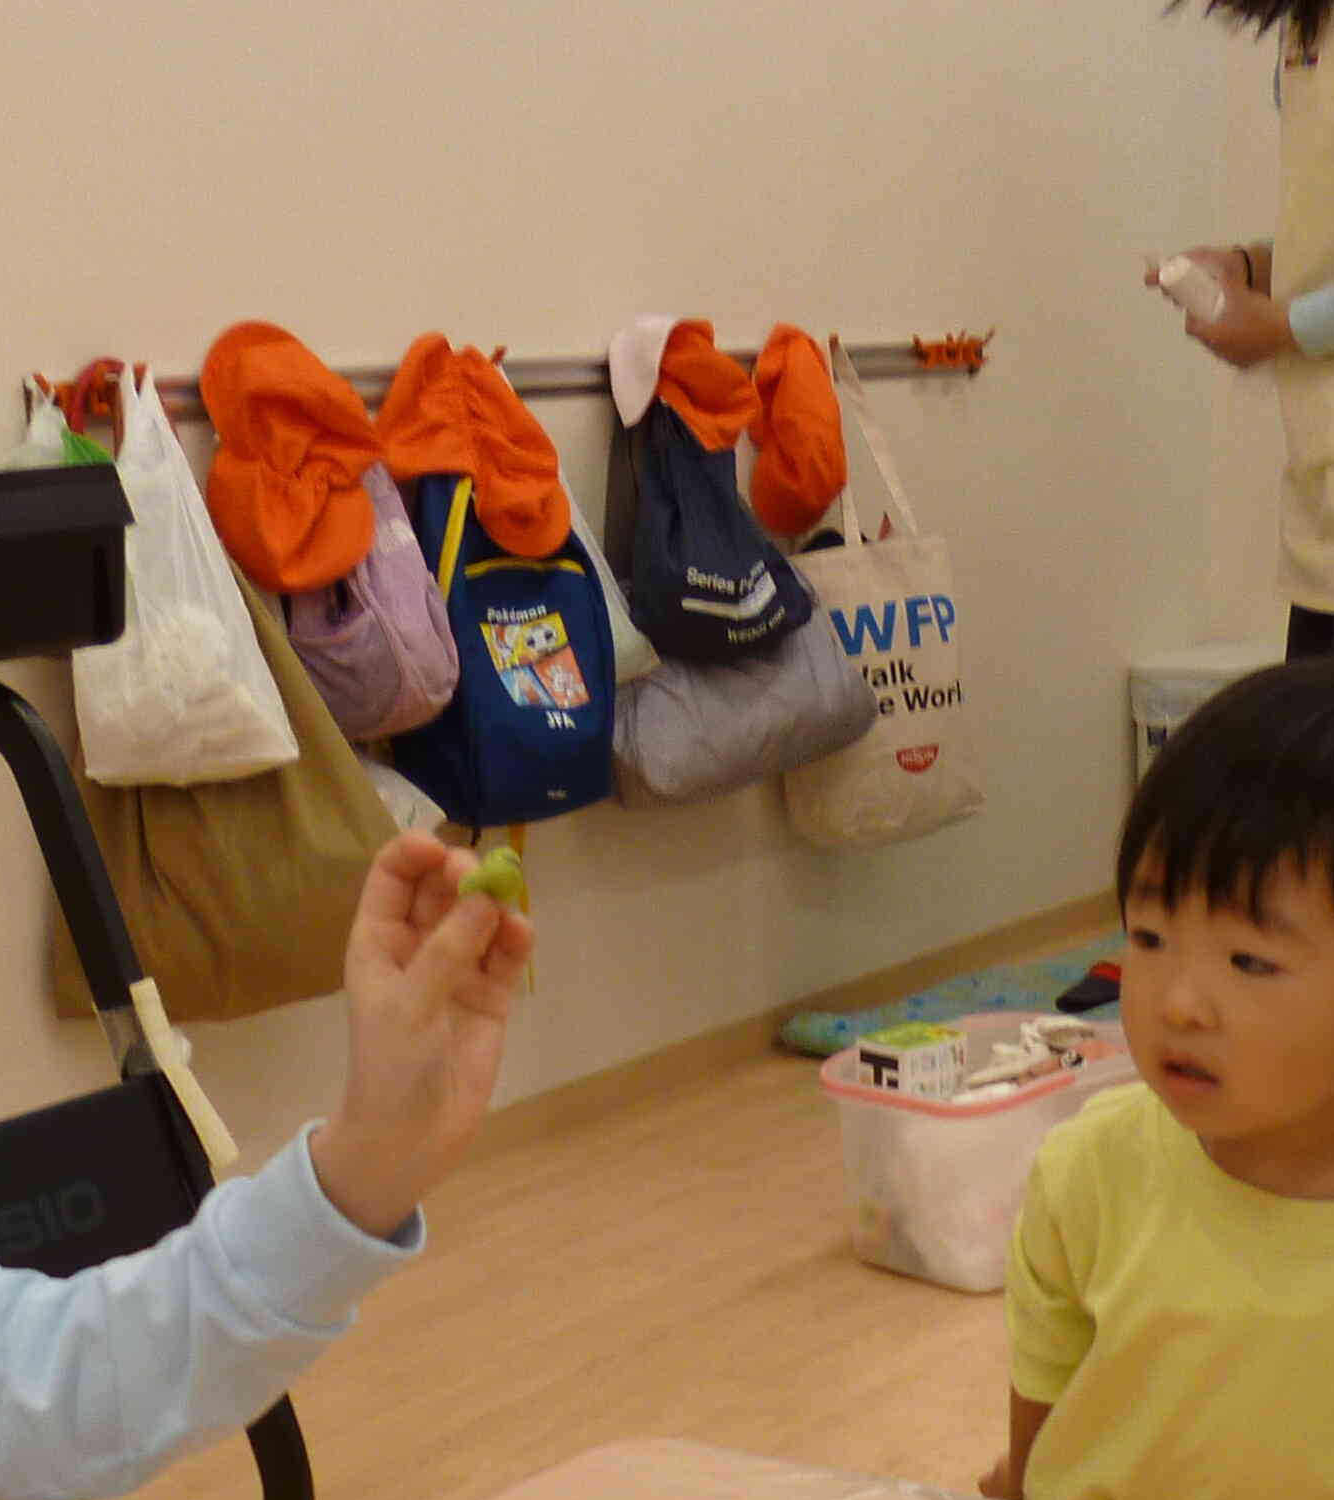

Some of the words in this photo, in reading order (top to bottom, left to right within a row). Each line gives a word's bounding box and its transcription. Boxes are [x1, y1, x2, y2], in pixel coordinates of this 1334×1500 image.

[687, 565, 735, 596] Series
[829, 594, 955, 657] WFP
[903, 680, 962, 713] Worl
